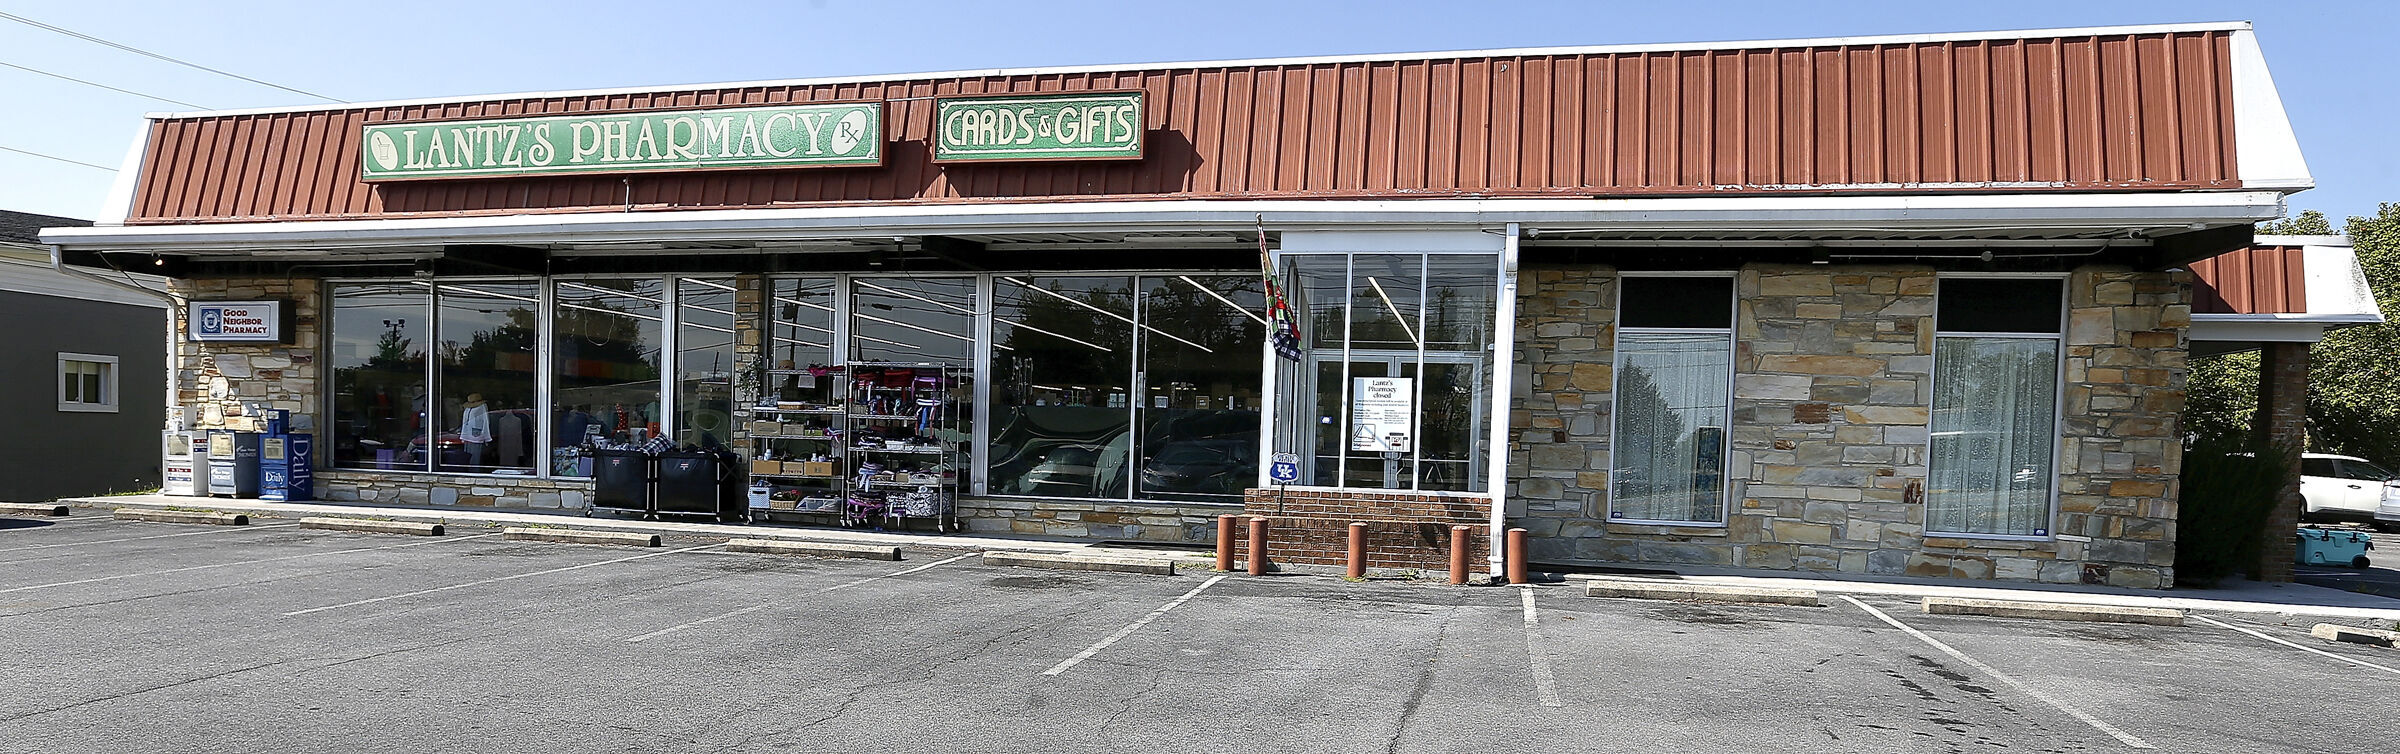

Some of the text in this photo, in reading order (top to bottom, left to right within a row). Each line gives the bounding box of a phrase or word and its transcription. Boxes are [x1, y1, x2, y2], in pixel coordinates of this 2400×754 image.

[945, 105, 1133, 146] CARDS & GIFTS
[403, 111, 832, 170] LANTZ'S PHARMACY
[223, 309, 247, 317] GOOD
[223, 317, 262, 325] NEIGHBOR
[223, 326, 267, 334] PHARMACY
[289, 439, 310, 491] Daily
[265, 471, 285, 484] Daily
